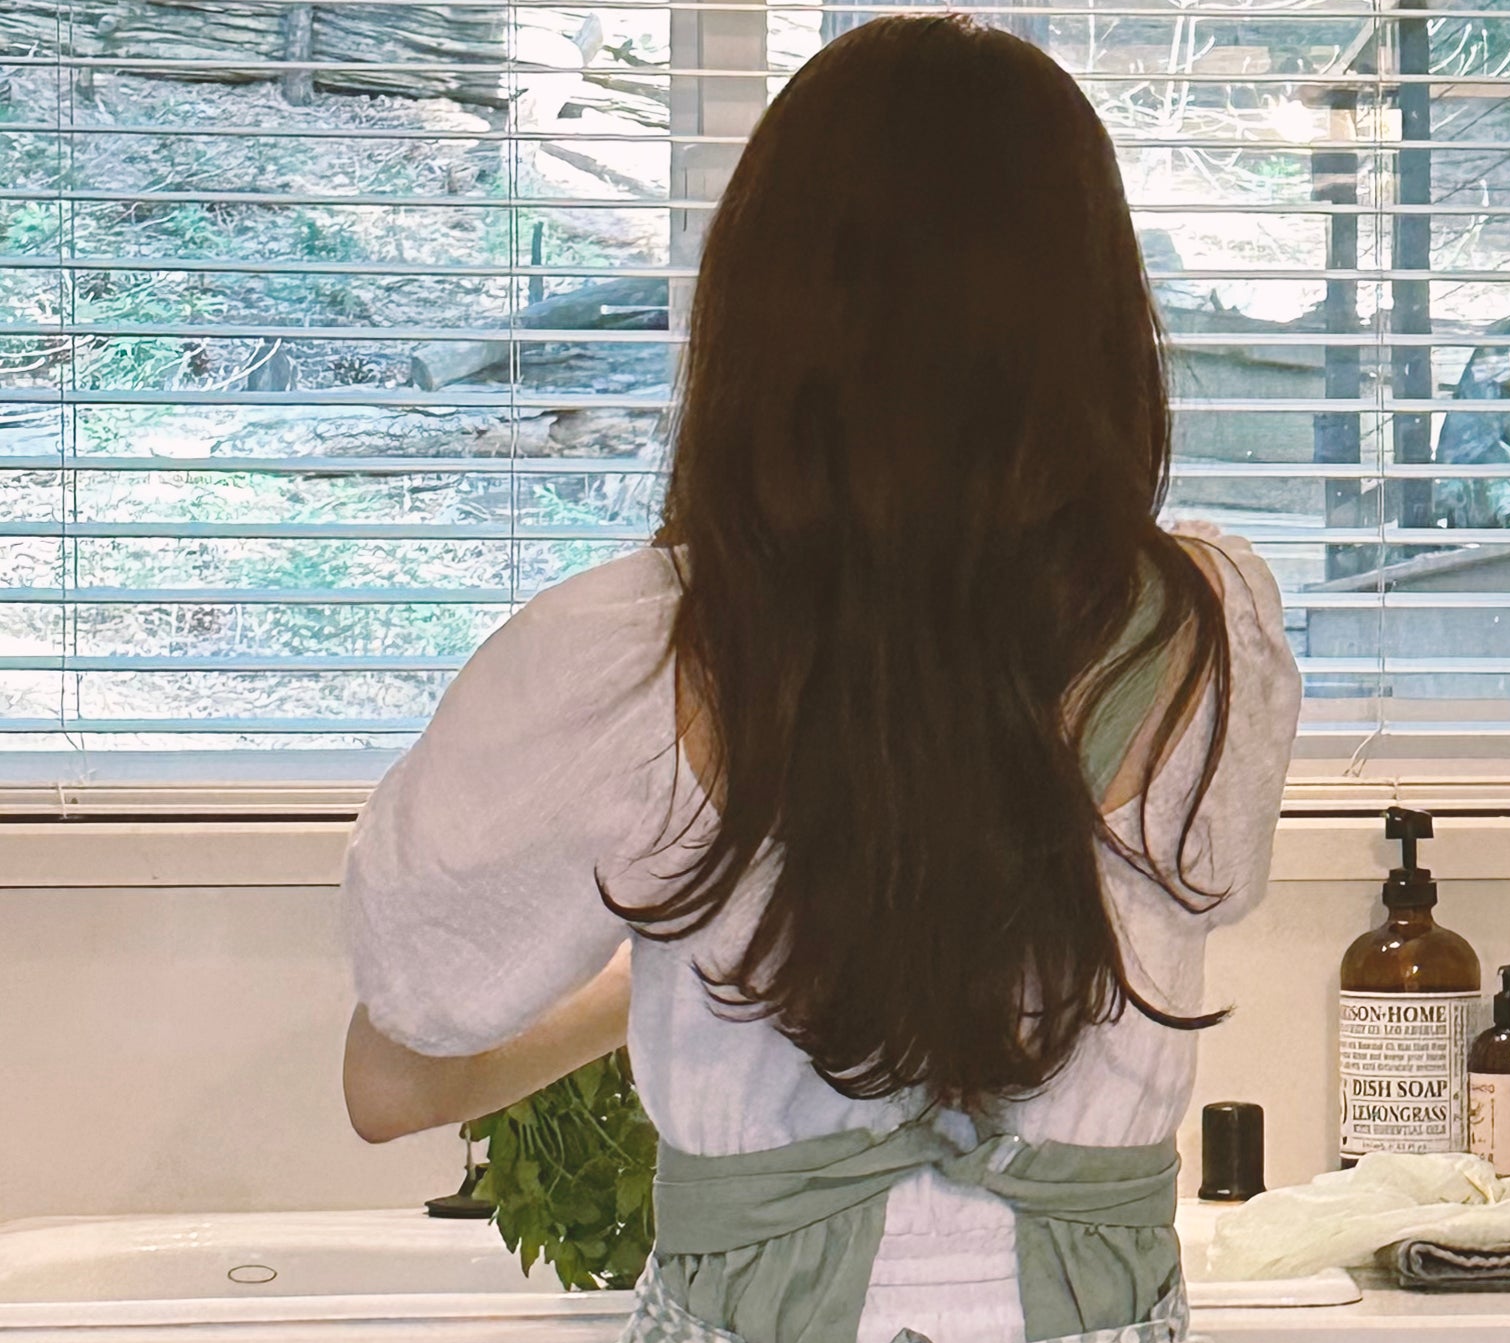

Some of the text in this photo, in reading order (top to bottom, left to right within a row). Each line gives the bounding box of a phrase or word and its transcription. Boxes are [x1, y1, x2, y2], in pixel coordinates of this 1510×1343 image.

[1353, 1079, 1448, 1098] DISH SOAP
[1352, 1104, 1447, 1122] LEMONGRASS
